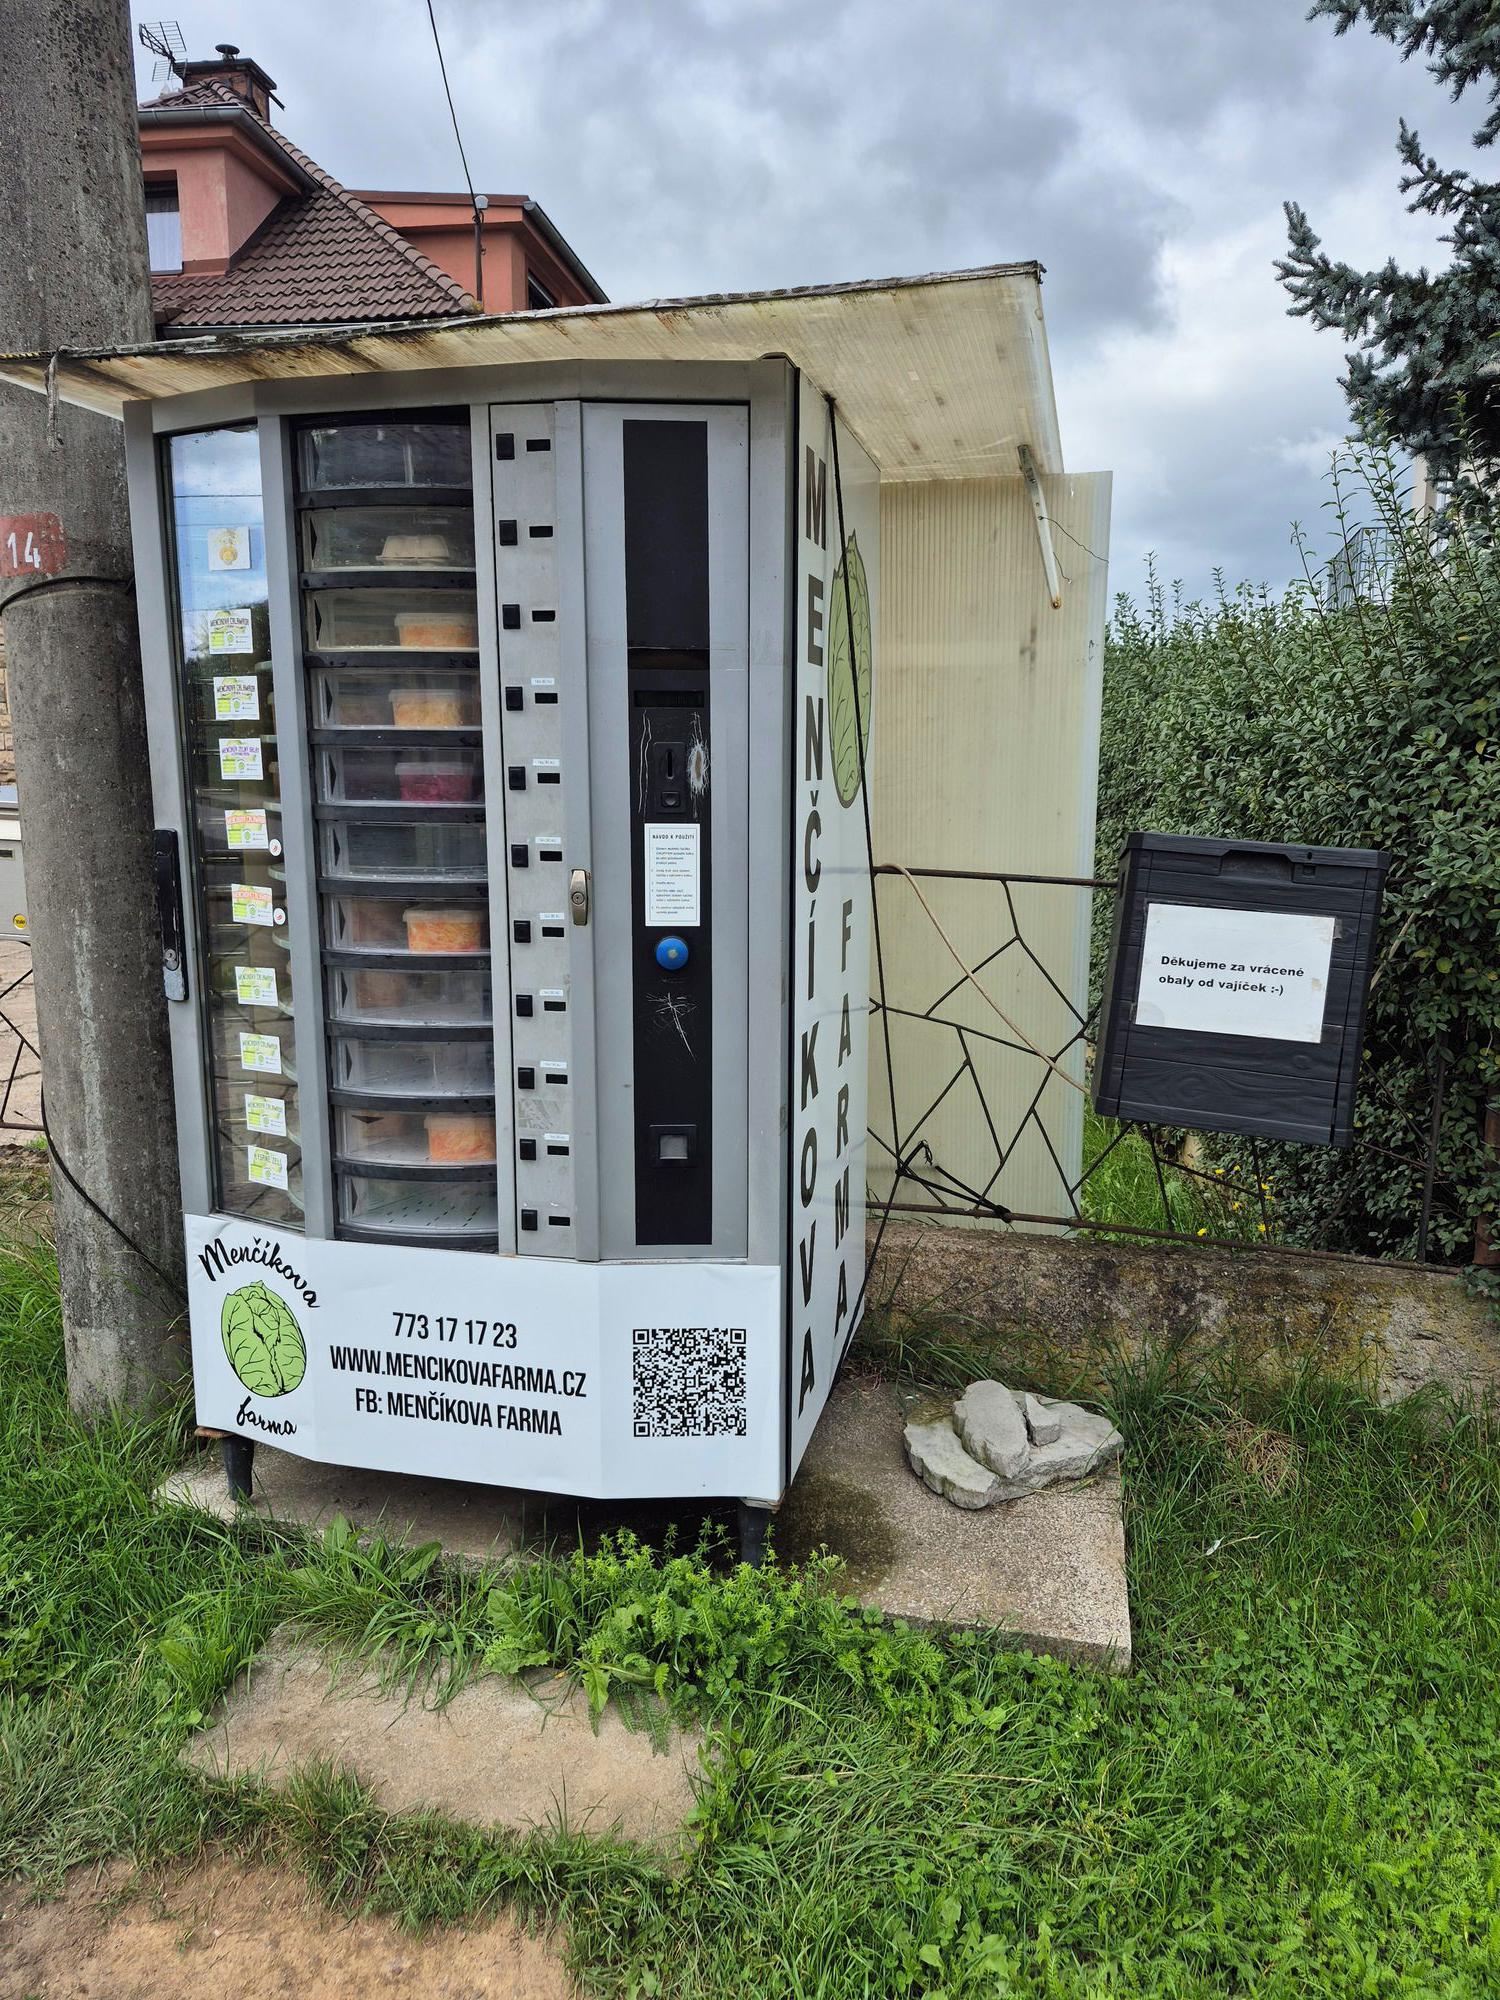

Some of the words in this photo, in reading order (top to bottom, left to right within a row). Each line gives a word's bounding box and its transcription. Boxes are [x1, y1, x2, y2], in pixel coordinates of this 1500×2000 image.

[7, 531, 41, 569] 14
[1158, 974, 1195, 988] obaly
[1197, 978, 1215, 988] od
[1218, 980, 1267, 993] vajíček
[1161, 955, 1227, 970] Děkujeme
[1230, 963, 1246, 972] za
[1249, 964, 1305, 977] vrácené
[833, 898, 853, 1341] FARMA
[197, 1236, 321, 1309] Menčíkova
[392, 1311, 429, 1340] 773
[435, 1316, 458, 1342] 17
[464, 1319, 488, 1346] 17
[492, 1322, 517, 1349] 23
[329, 1345, 587, 1398] WWW.MENCIKOVAFARMA.CZ
[235, 1395, 298, 1437] farma
[355, 1387, 383, 1414] FB:
[387, 1390, 493, 1428] MENČÍKOVA
[497, 1404, 562, 1436] FARMA
